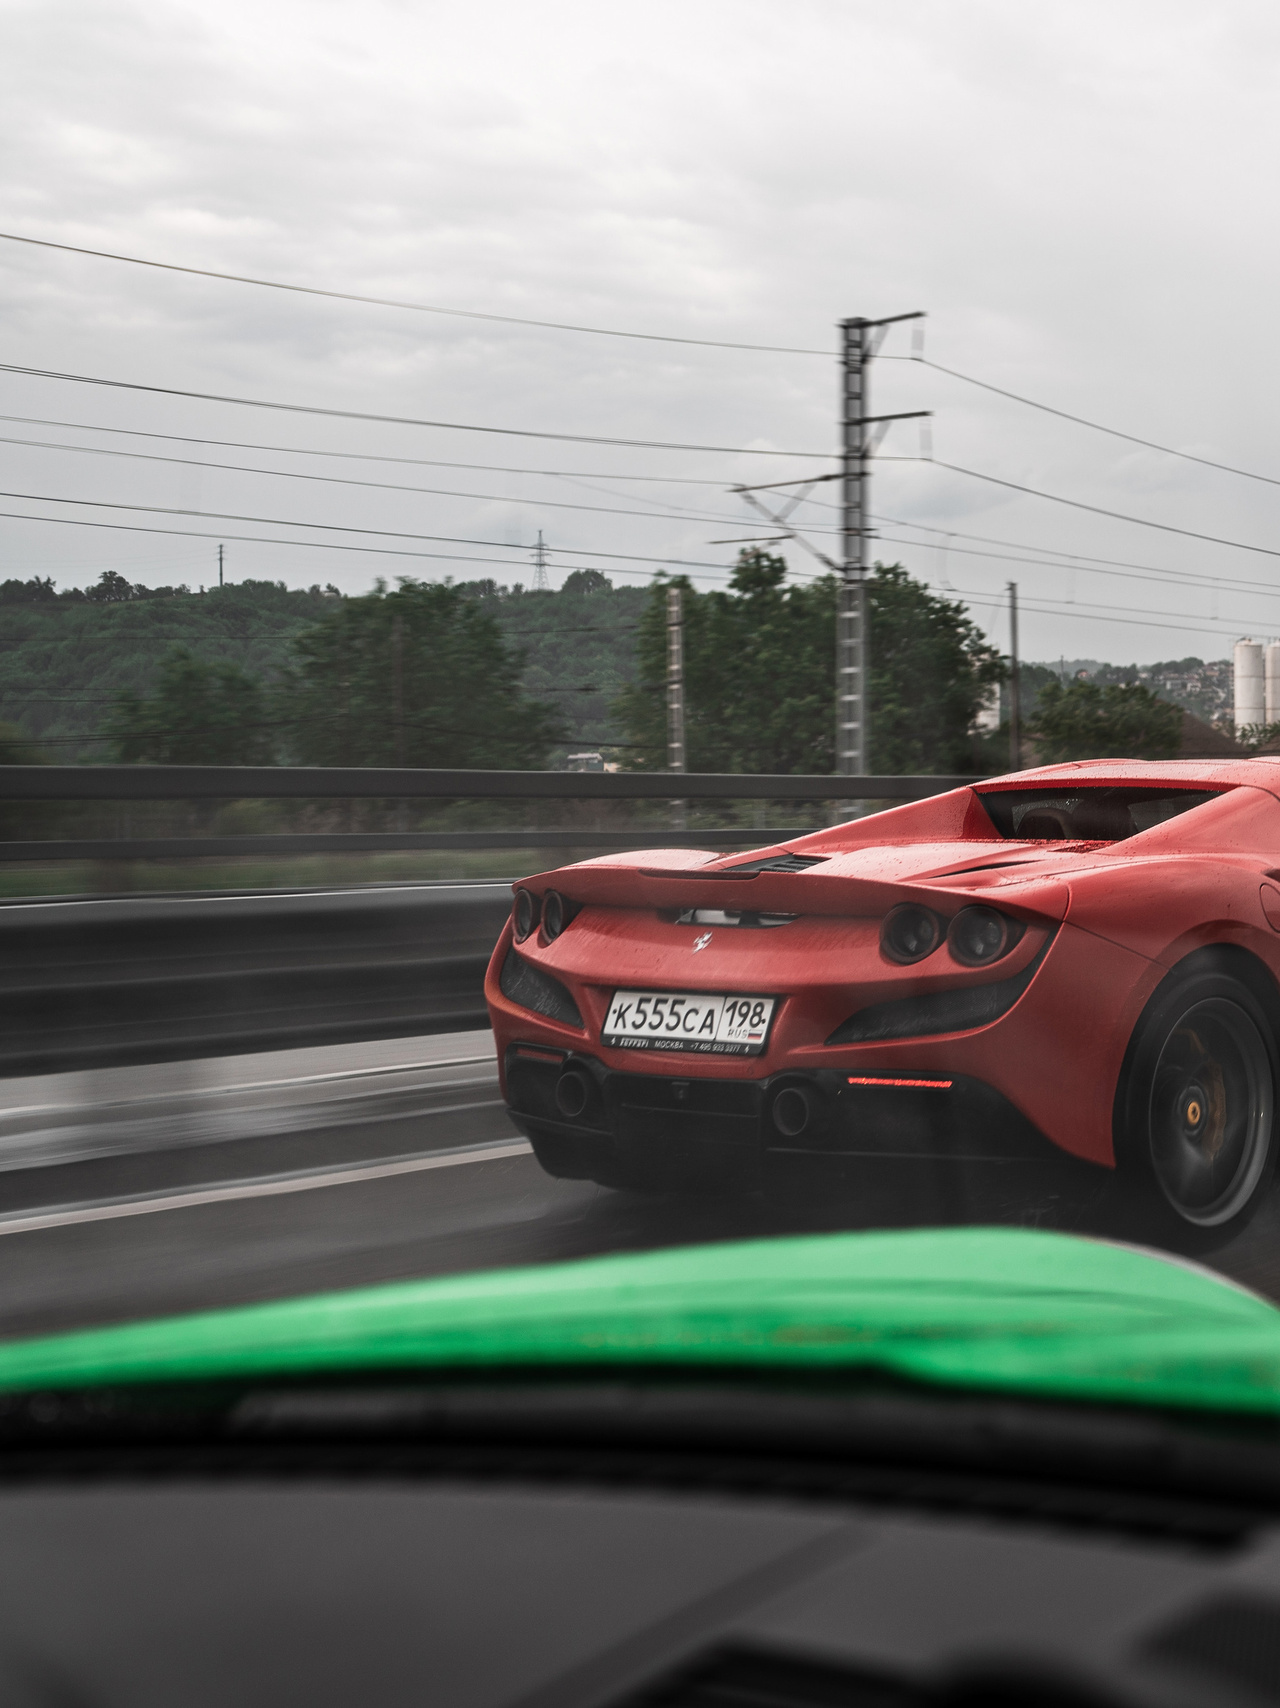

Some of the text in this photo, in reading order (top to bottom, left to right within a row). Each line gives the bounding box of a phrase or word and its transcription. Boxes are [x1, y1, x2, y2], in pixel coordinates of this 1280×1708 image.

[613, 997, 765, 1035] К555СА 198
[727, 1028, 748, 1039] RUS
[654, 1039, 684, 1050] МОСКВА
